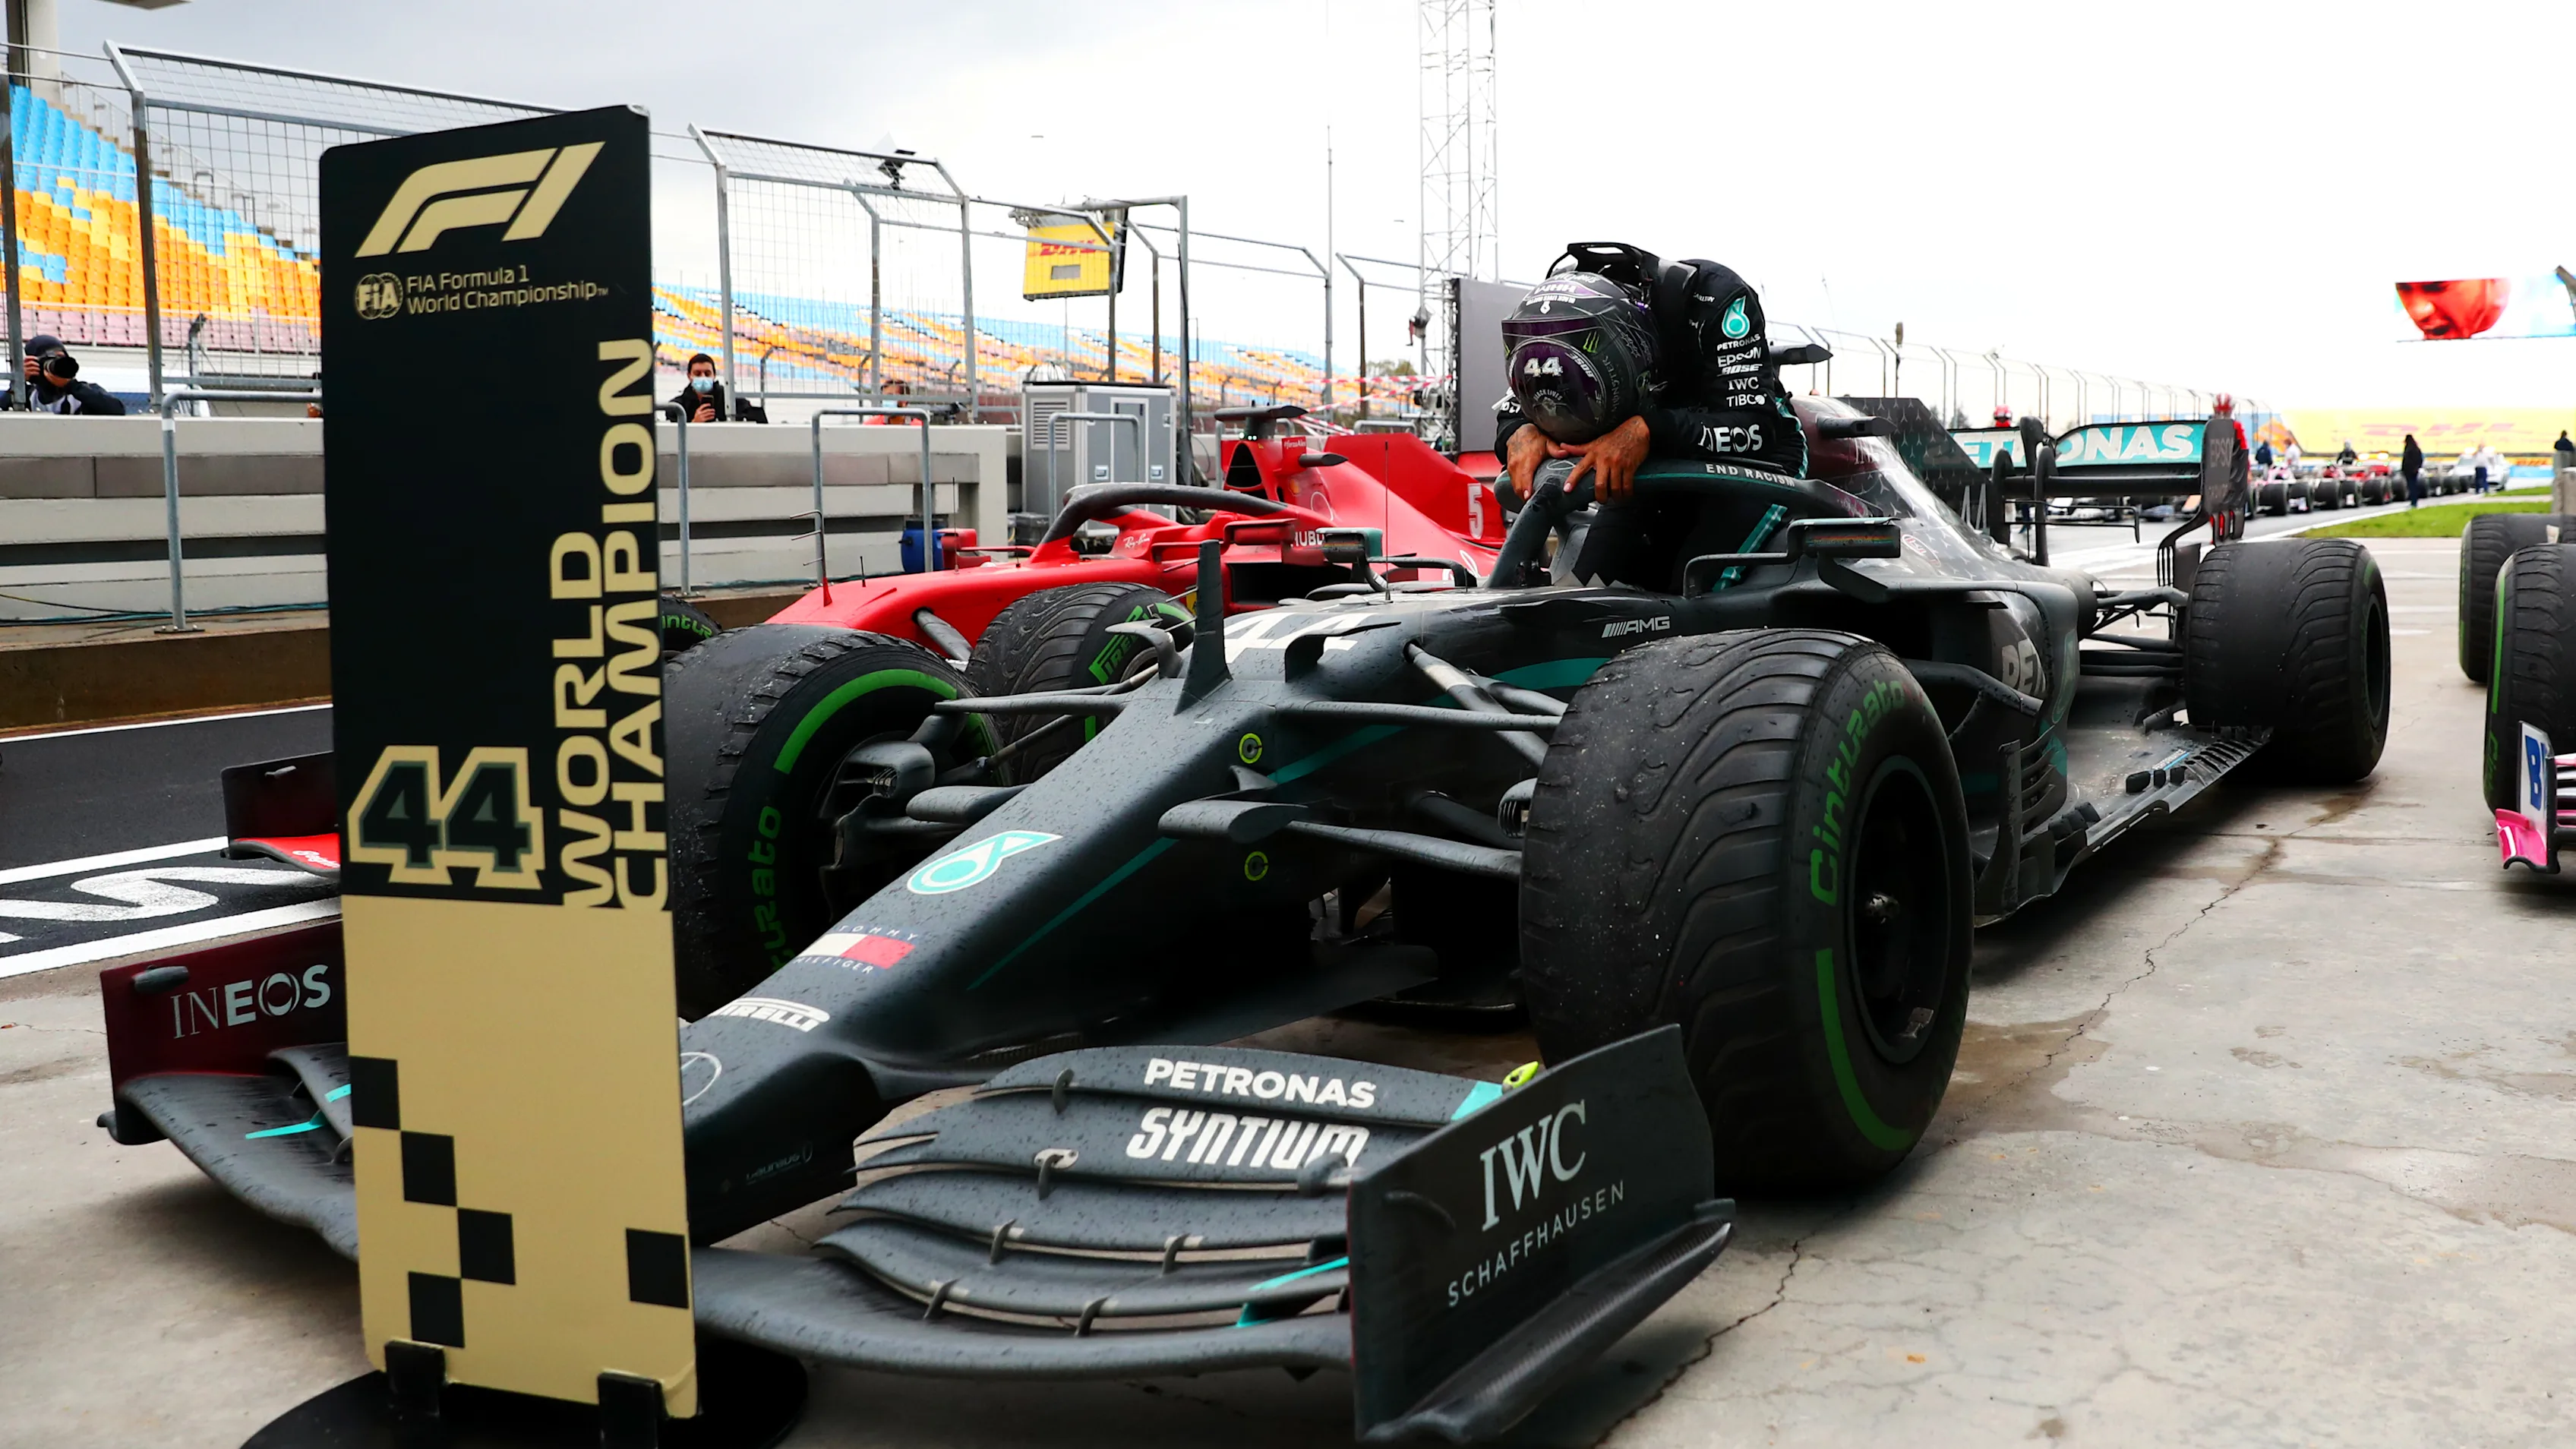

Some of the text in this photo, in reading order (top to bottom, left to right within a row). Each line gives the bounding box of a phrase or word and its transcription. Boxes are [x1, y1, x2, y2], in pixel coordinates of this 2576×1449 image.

[406, 264, 530, 294] FIA Formula 1
[407, 292, 460, 315] World
[1717, 333, 1760, 351] PETRONAS
[1717, 346, 1762, 368] EPSON
[1523, 356, 1564, 377] 44
[1716, 364, 1763, 377] BOSE
[1728, 377, 1759, 390] IWC
[1705, 463, 1795, 487] END RACISM
[1466, 483, 1484, 540] 5
[598, 339, 670, 911] CHAMPION
[551, 532, 614, 908] WORLD
[347, 745, 545, 889] 44
[838, 925, 919, 941] TOMMY
[793, 956, 874, 974] HILFIGER
[170, 964, 331, 1040] INEOS
[1144, 1058, 1378, 1109] PETRONAS
[1125, 1107, 1370, 1170] SYNTIUM
[1479, 1099, 1586, 1232] IWC
[1447, 1179, 1625, 1308] SCHAFFHAUSEN
